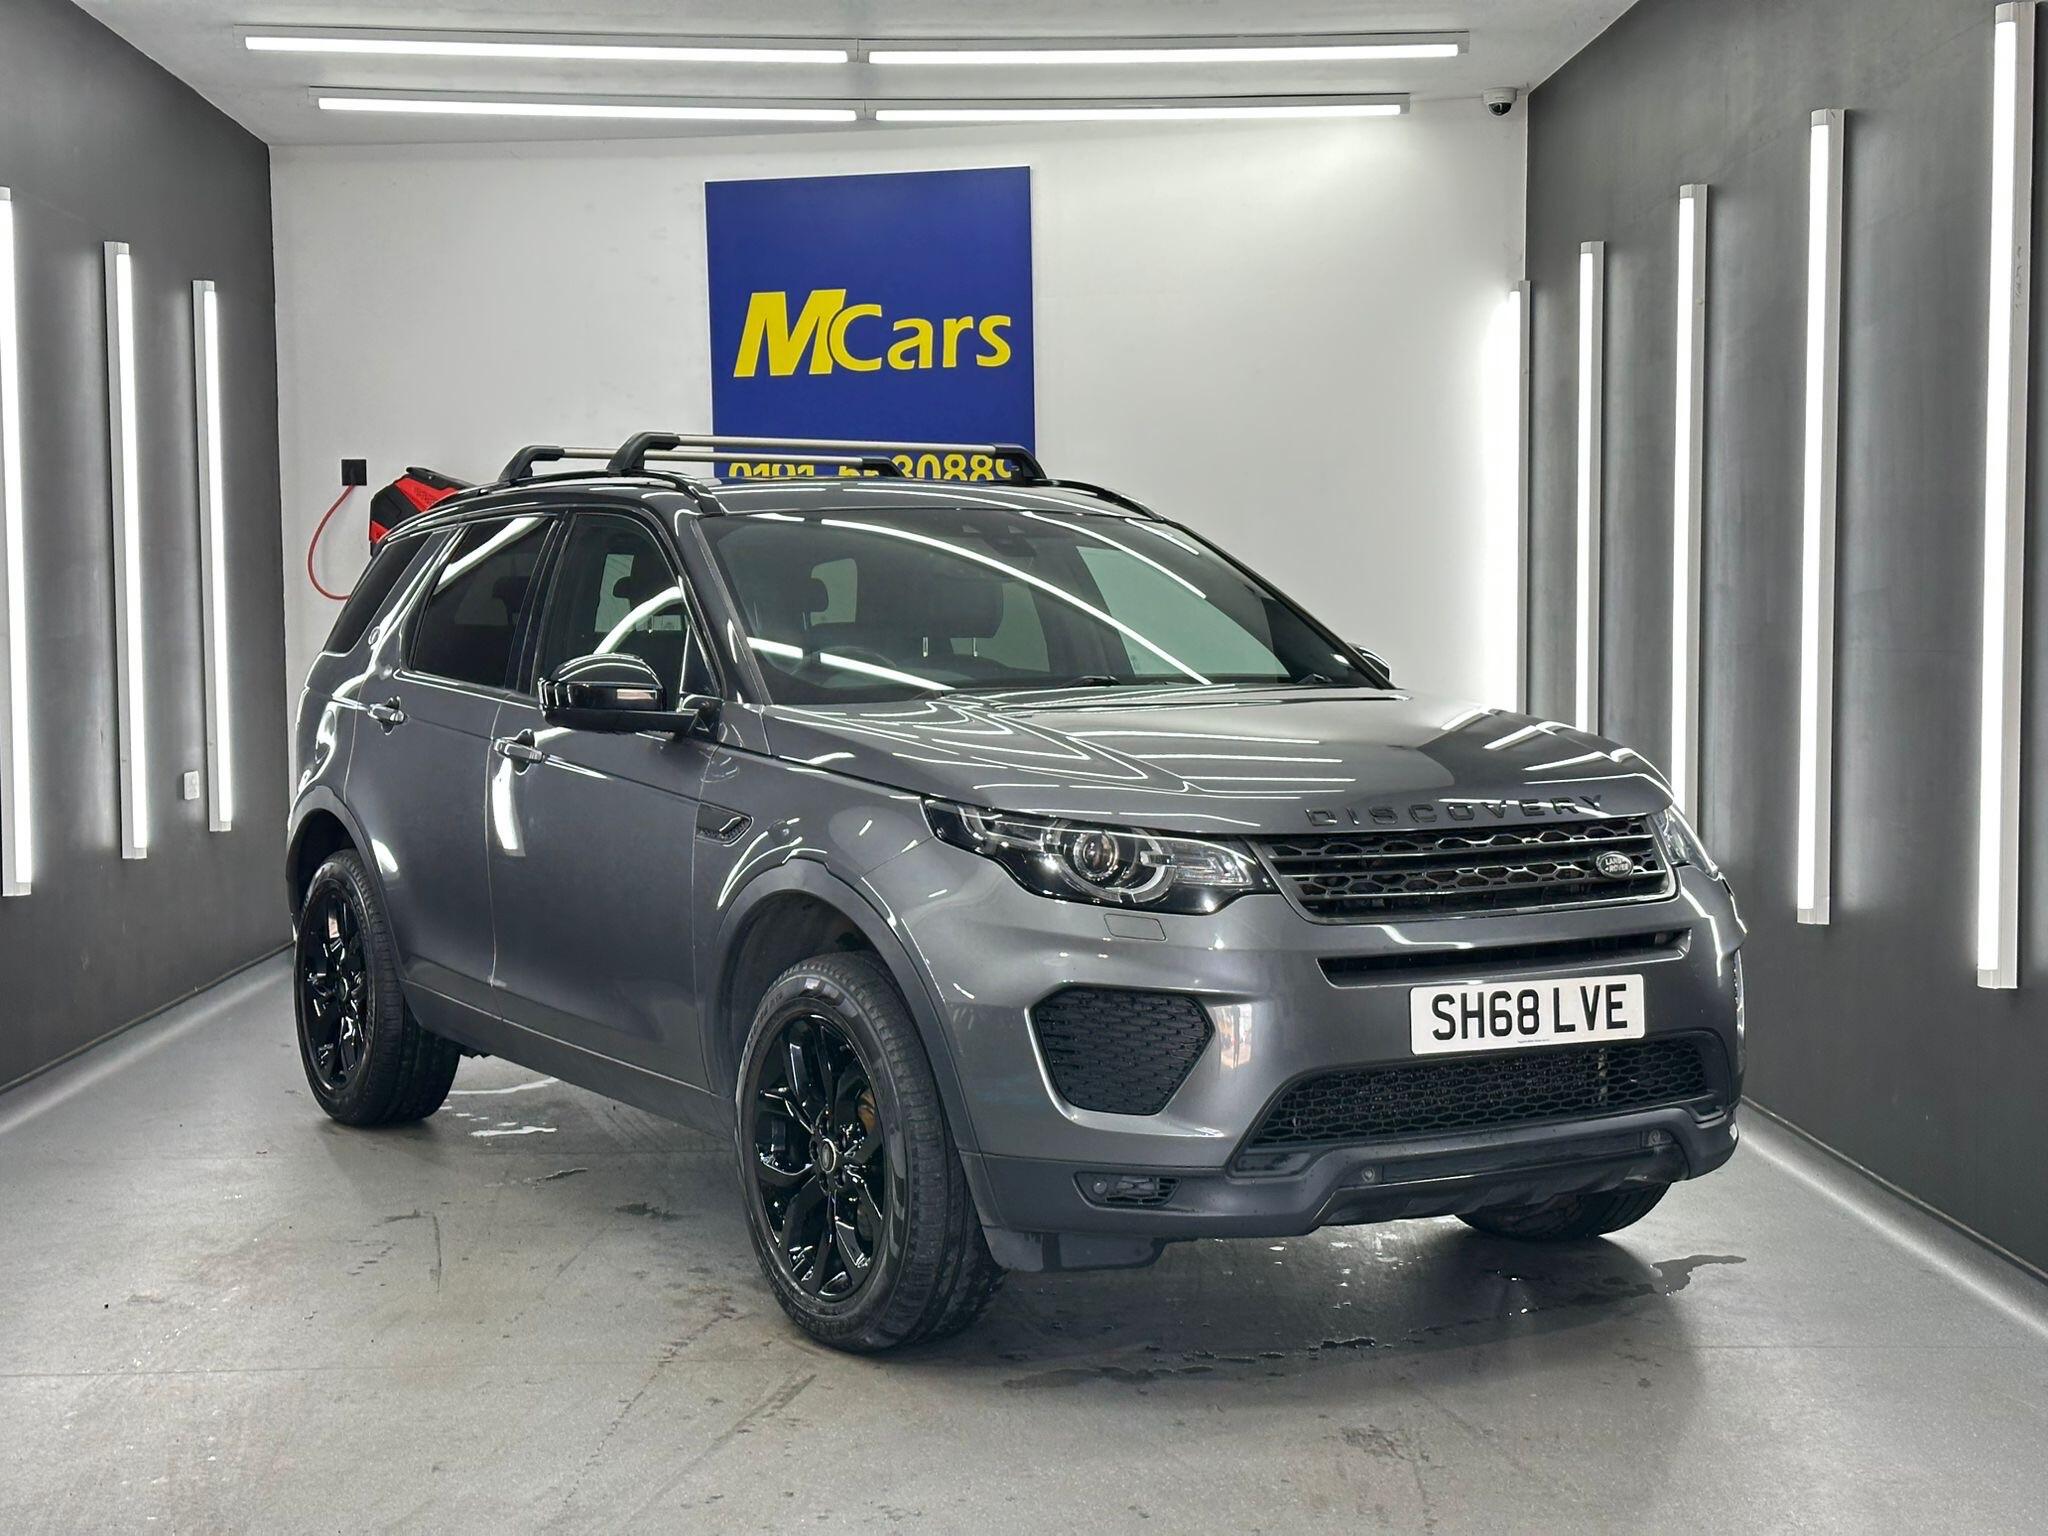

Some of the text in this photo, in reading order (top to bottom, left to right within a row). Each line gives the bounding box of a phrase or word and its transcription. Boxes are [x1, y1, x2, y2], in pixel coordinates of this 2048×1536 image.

[733, 288, 1012, 378] MCars
[1305, 794, 1602, 826] DISCOVERY
[1432, 983, 1628, 1041] SH68 LVE
